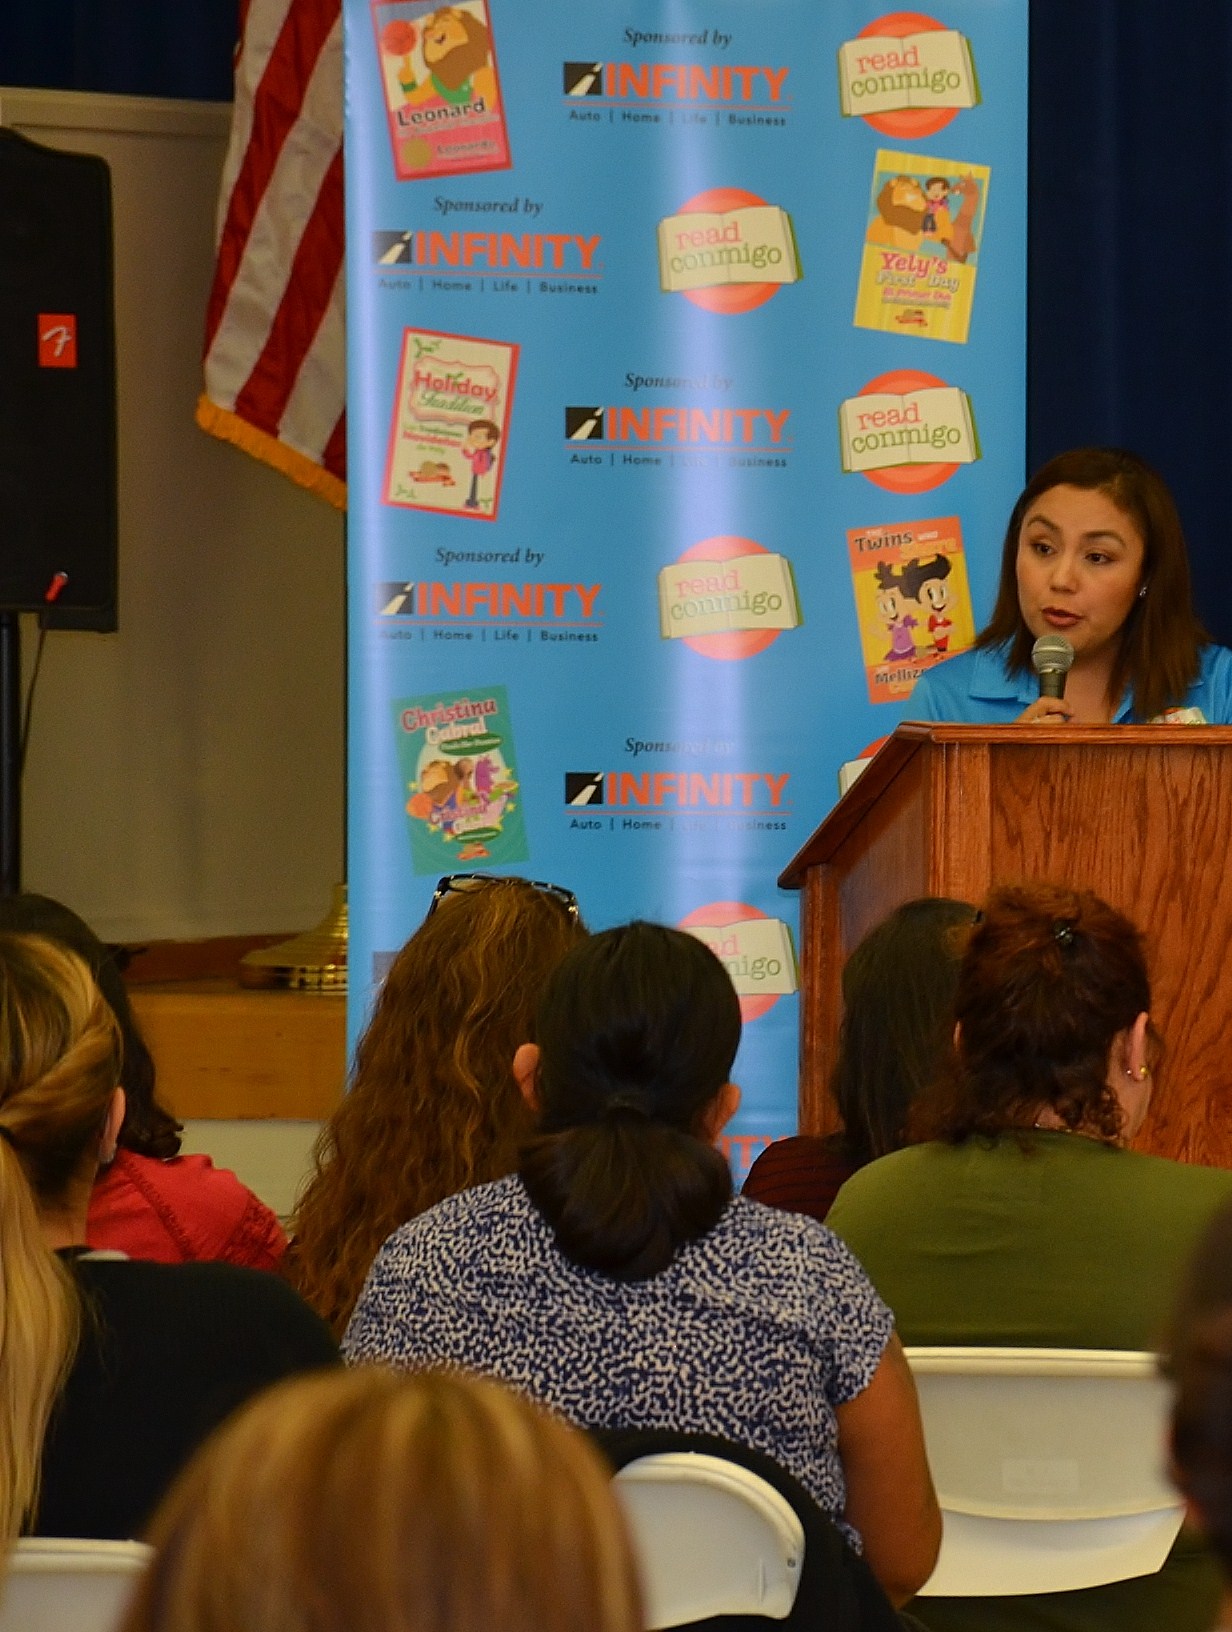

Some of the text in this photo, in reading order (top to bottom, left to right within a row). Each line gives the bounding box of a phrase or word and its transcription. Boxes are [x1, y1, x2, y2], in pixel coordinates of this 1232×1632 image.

[624, 27, 733, 49] Sponsored by
[857, 46, 920, 75] read
[605, 62, 790, 101] INFINITY
[851, 68, 961, 97] conmigo
[397, 96, 485, 126] Leonard
[570, 109, 601, 122] Auto
[622, 110, 660, 123] Home
[728, 112, 787, 127] Business
[433, 196, 544, 217] Sponsored by
[415, 230, 602, 270] INFINITY
[676, 221, 742, 250] read
[670, 243, 783, 274] conmigo
[881, 252, 948, 278] Yely's
[379, 278, 599, 295] Auto Home Life Business
[414, 370, 498, 403] Holiday
[625, 372, 706, 392] Sponsord
[607, 407, 791, 443] INFINITY
[857, 402, 921, 432] read
[851, 425, 962, 454] conmigo
[570, 453, 602, 465] Auto
[622, 453, 662, 466] Home
[855, 531, 912, 552] Twins
[435, 547, 545, 567] Sponsored by
[674, 569, 742, 599] read
[417, 581, 602, 618] INFINITY
[670, 589, 783, 621] conmigo
[433, 629, 473, 641] Home
[494, 629, 519, 641] Life
[540, 630, 599, 643] Business
[606, 772, 791, 806] INFINITY
[570, 818, 602, 830] Auto
[622, 818, 662, 830] Home
